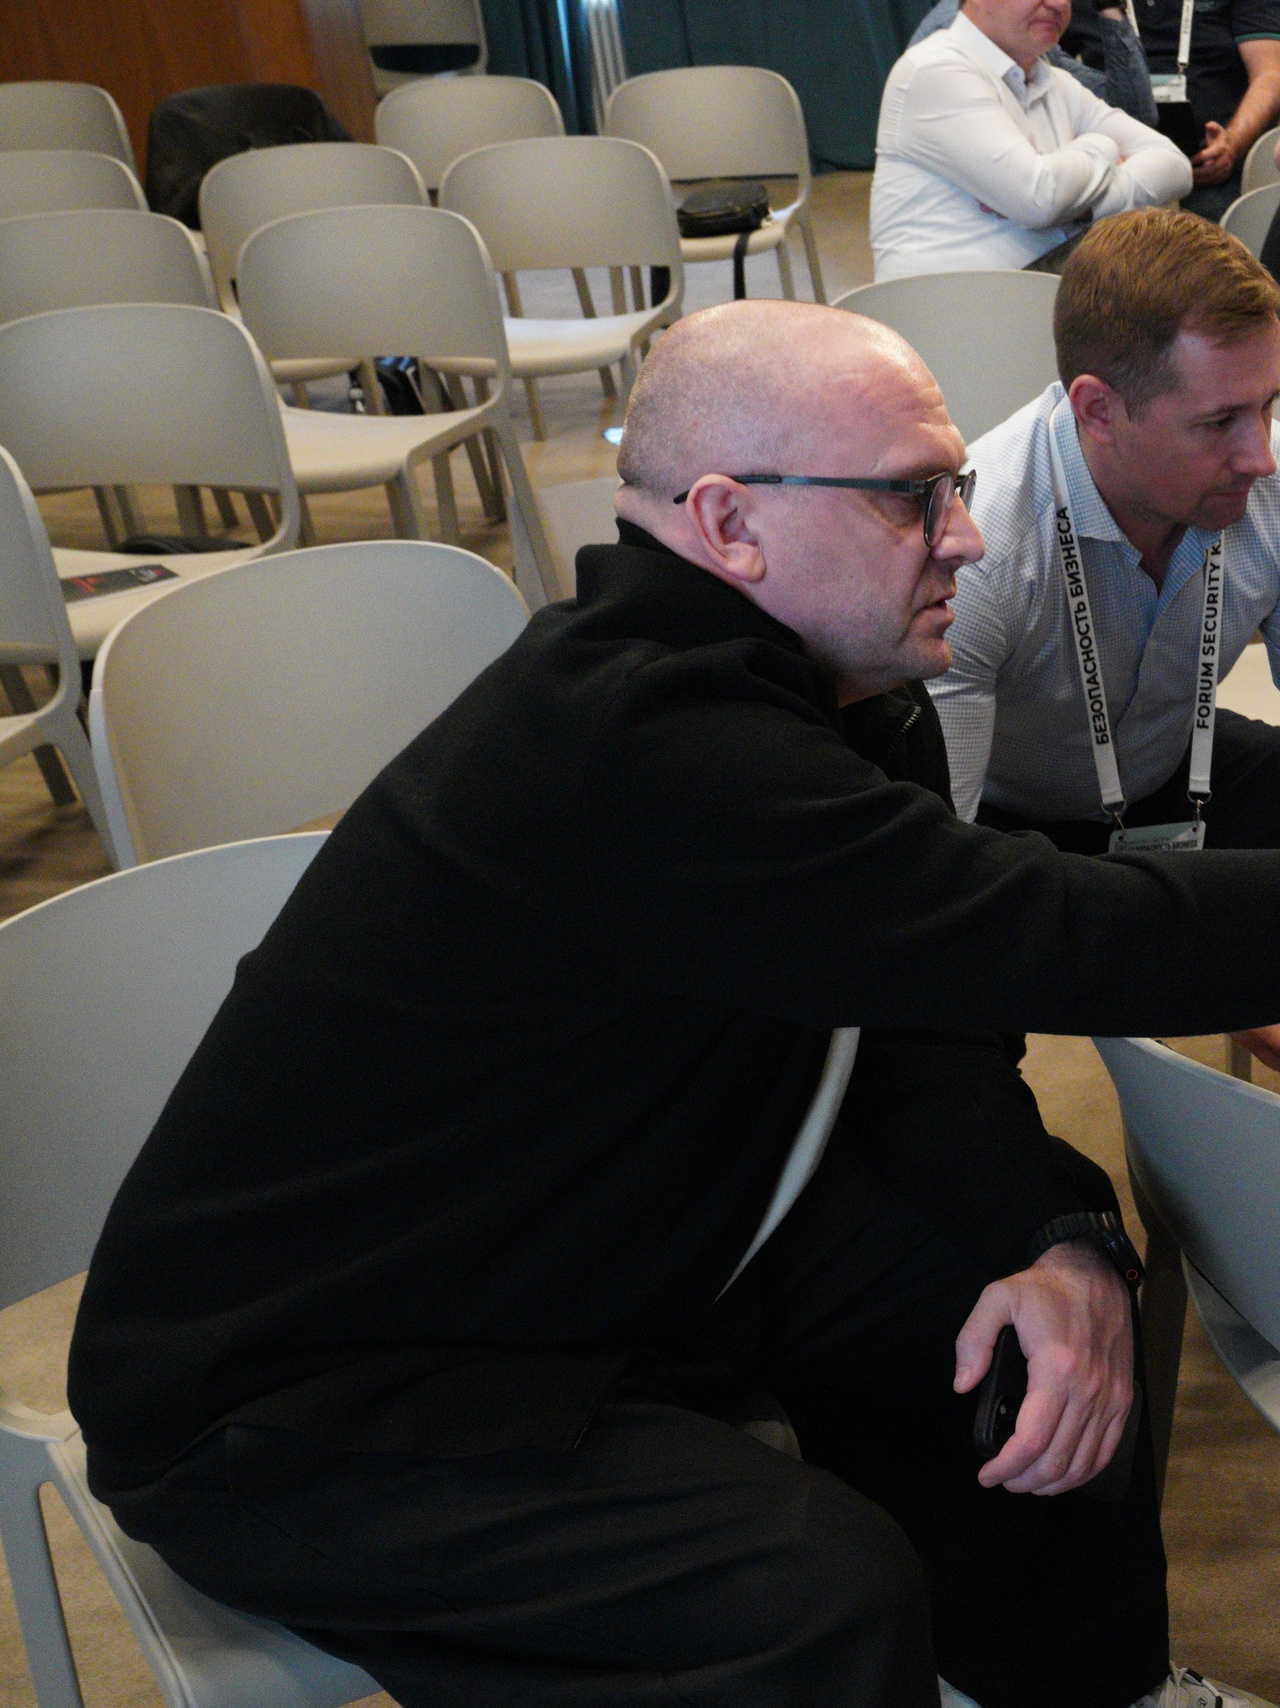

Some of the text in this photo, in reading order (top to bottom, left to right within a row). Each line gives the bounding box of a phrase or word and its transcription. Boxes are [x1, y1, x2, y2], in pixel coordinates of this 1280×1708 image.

[1056, 507, 1109, 745] БЕЗОПАСНОСТЬ БИЗНЕСА
[1203, 562, 1220, 656] SECURITY
[1196, 662, 1214, 730] FORUM
